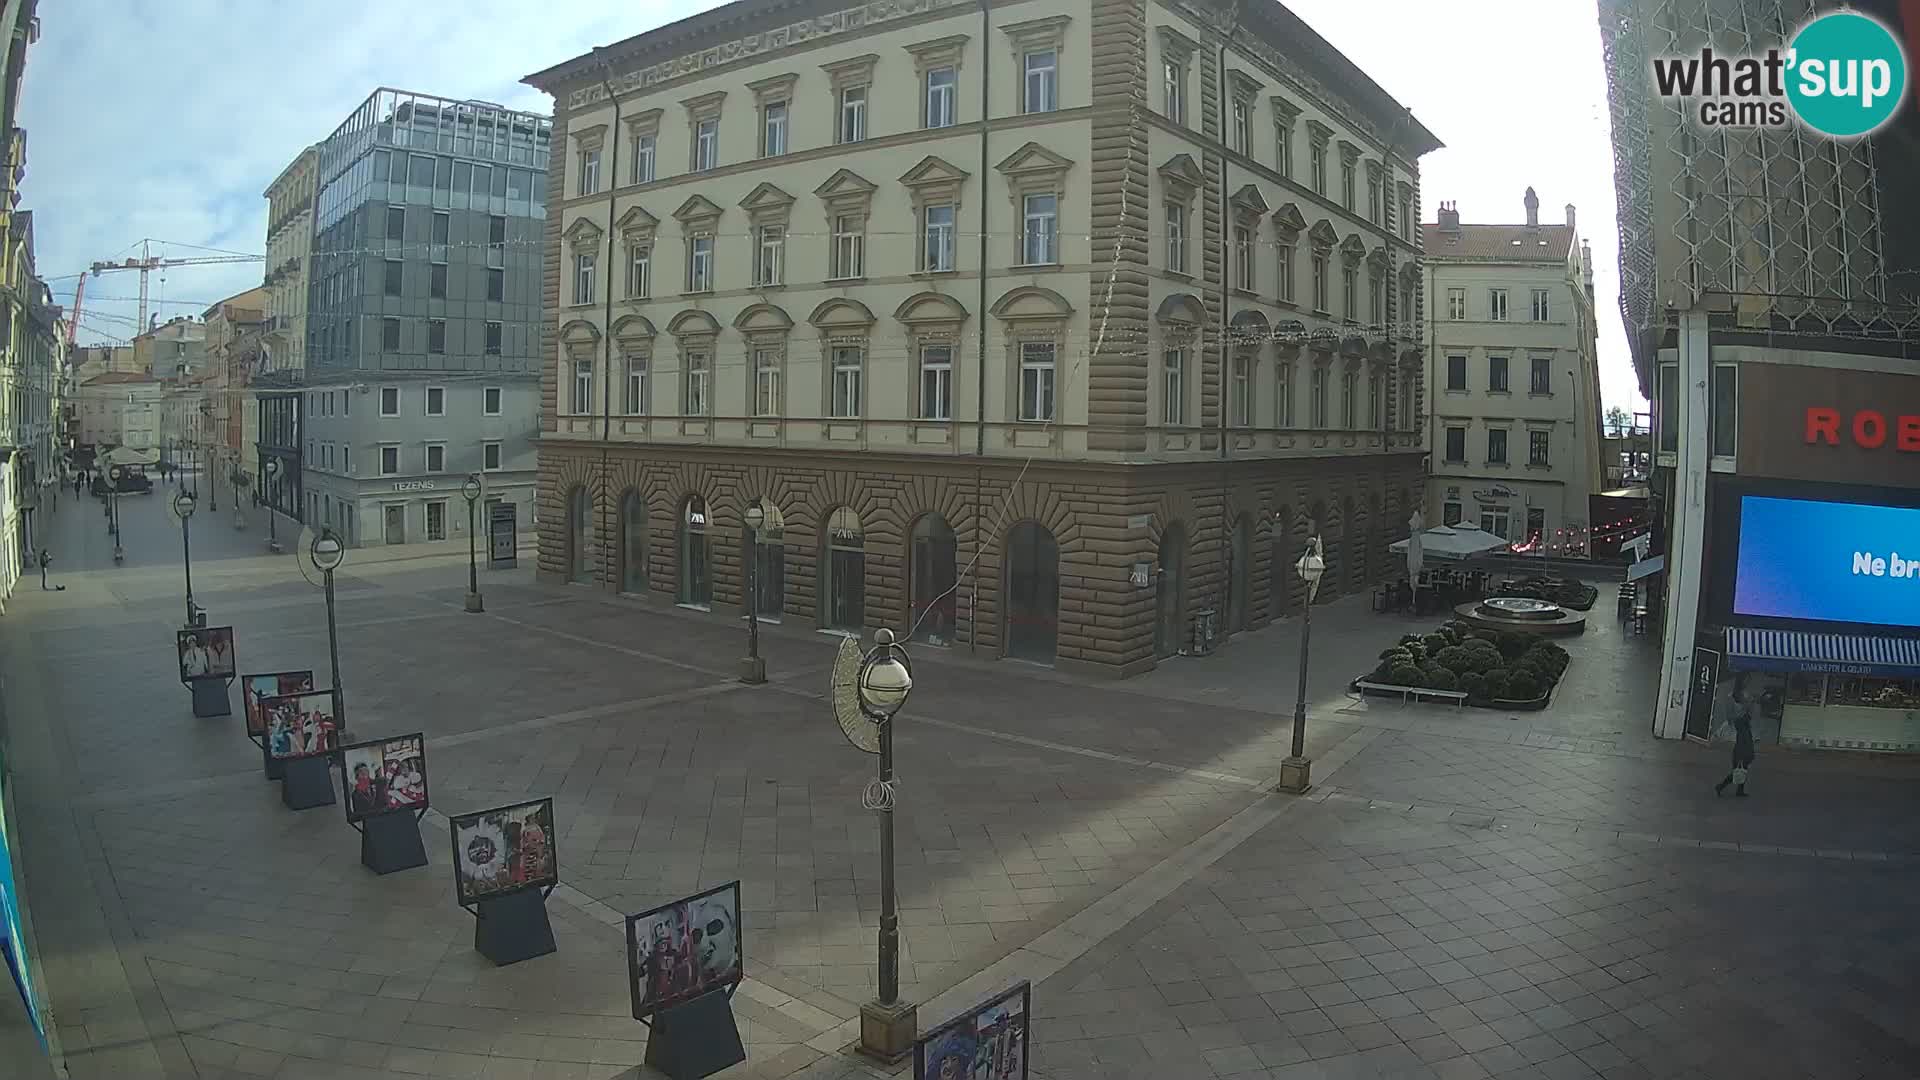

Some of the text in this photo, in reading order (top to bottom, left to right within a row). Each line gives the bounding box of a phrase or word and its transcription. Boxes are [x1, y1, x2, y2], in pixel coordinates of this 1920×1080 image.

[393, 480, 434, 491] TEZENIS
[1852, 551, 1920, 578] Ne br
